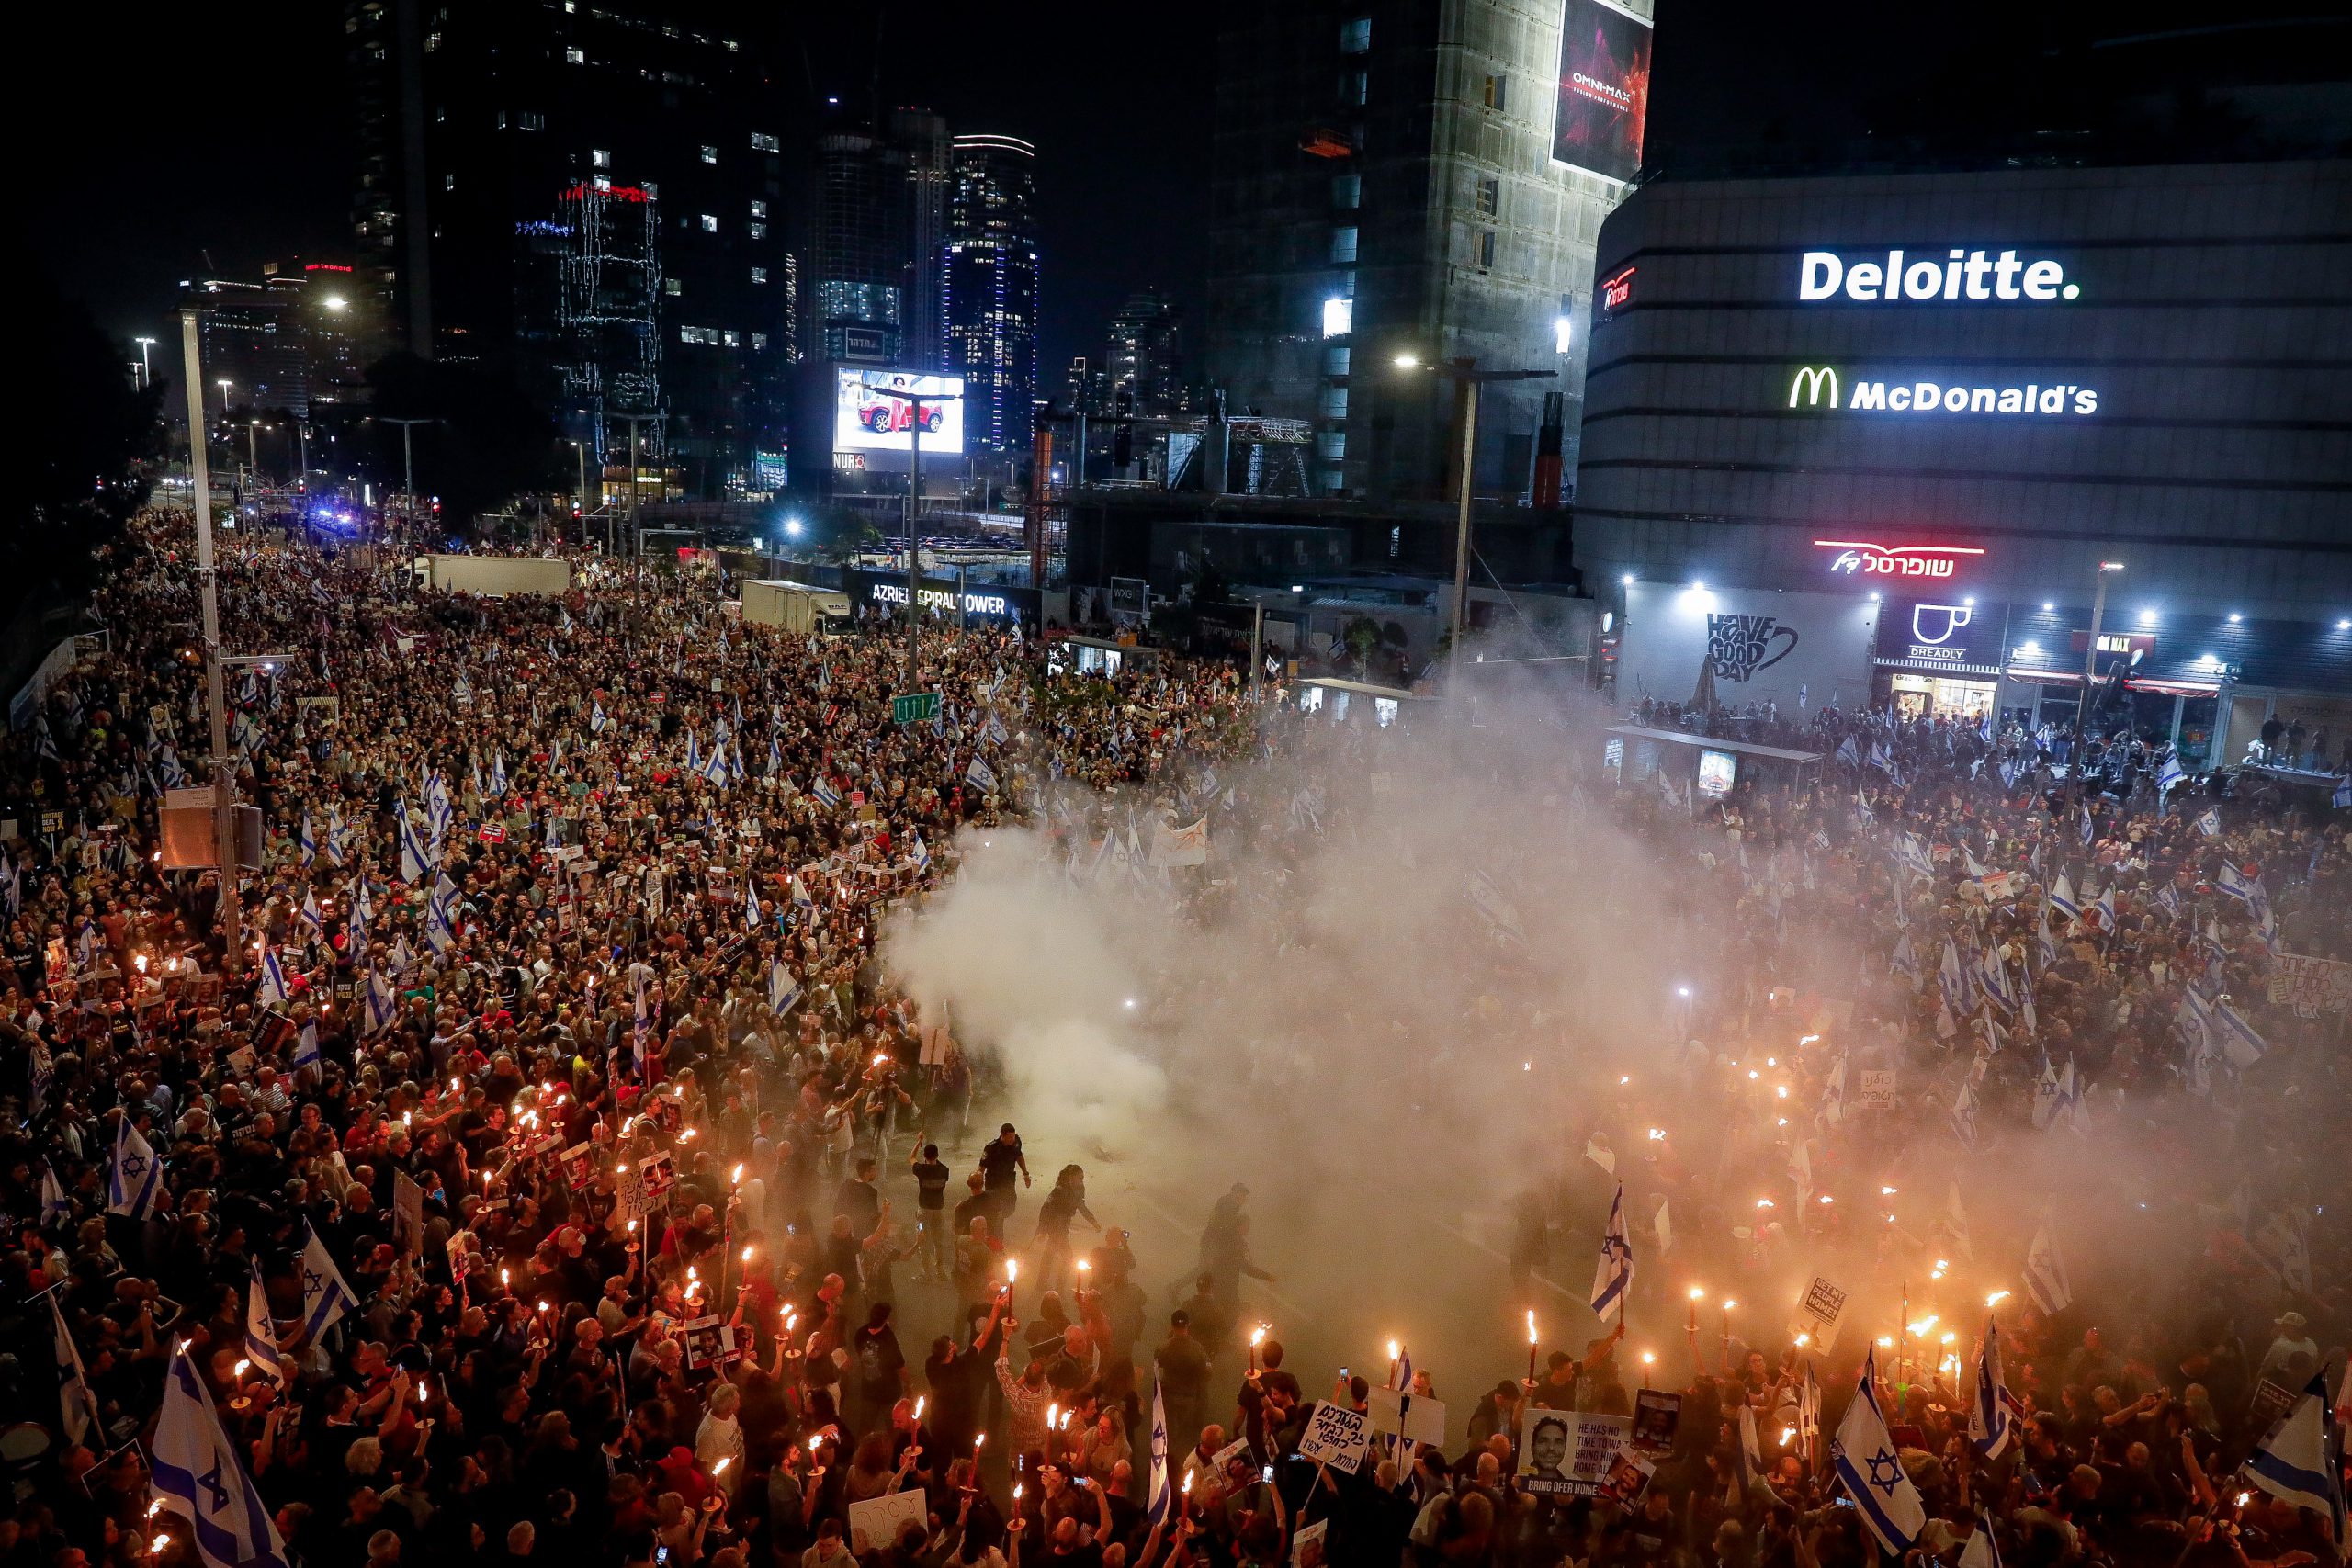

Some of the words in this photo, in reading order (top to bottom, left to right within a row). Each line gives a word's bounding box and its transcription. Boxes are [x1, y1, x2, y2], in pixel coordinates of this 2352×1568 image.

[1573, 72, 1631, 103] OMNI-MAX
[1800, 249, 2080, 300] Deloitte.
[1849, 381, 2098, 414] McDonald's
[1862, 551, 1954, 578] שופרסל
[957, 593, 1005, 615] OWER
[1114, 587, 1133, 599] WXG
[1709, 637, 1766, 666] GOOD
[1713, 661, 1758, 682] DAY
[1808, 1294, 1838, 1319] HOME!
[1812, 1287, 1841, 1309] PEOPLE
[1578, 1422, 1589, 1434] HE
[1590, 1425, 1607, 1436] HAS
[1608, 1426, 1620, 1437] NO
[1577, 1436, 1597, 1448] TIME
[1598, 1438, 1608, 1449] TO
[1575, 1449, 1600, 1461] BRING
[1573, 1461, 1597, 1473] HOME
[1528, 1480, 1553, 1492] BRING
[1553, 1481, 1573, 1495] OFER
